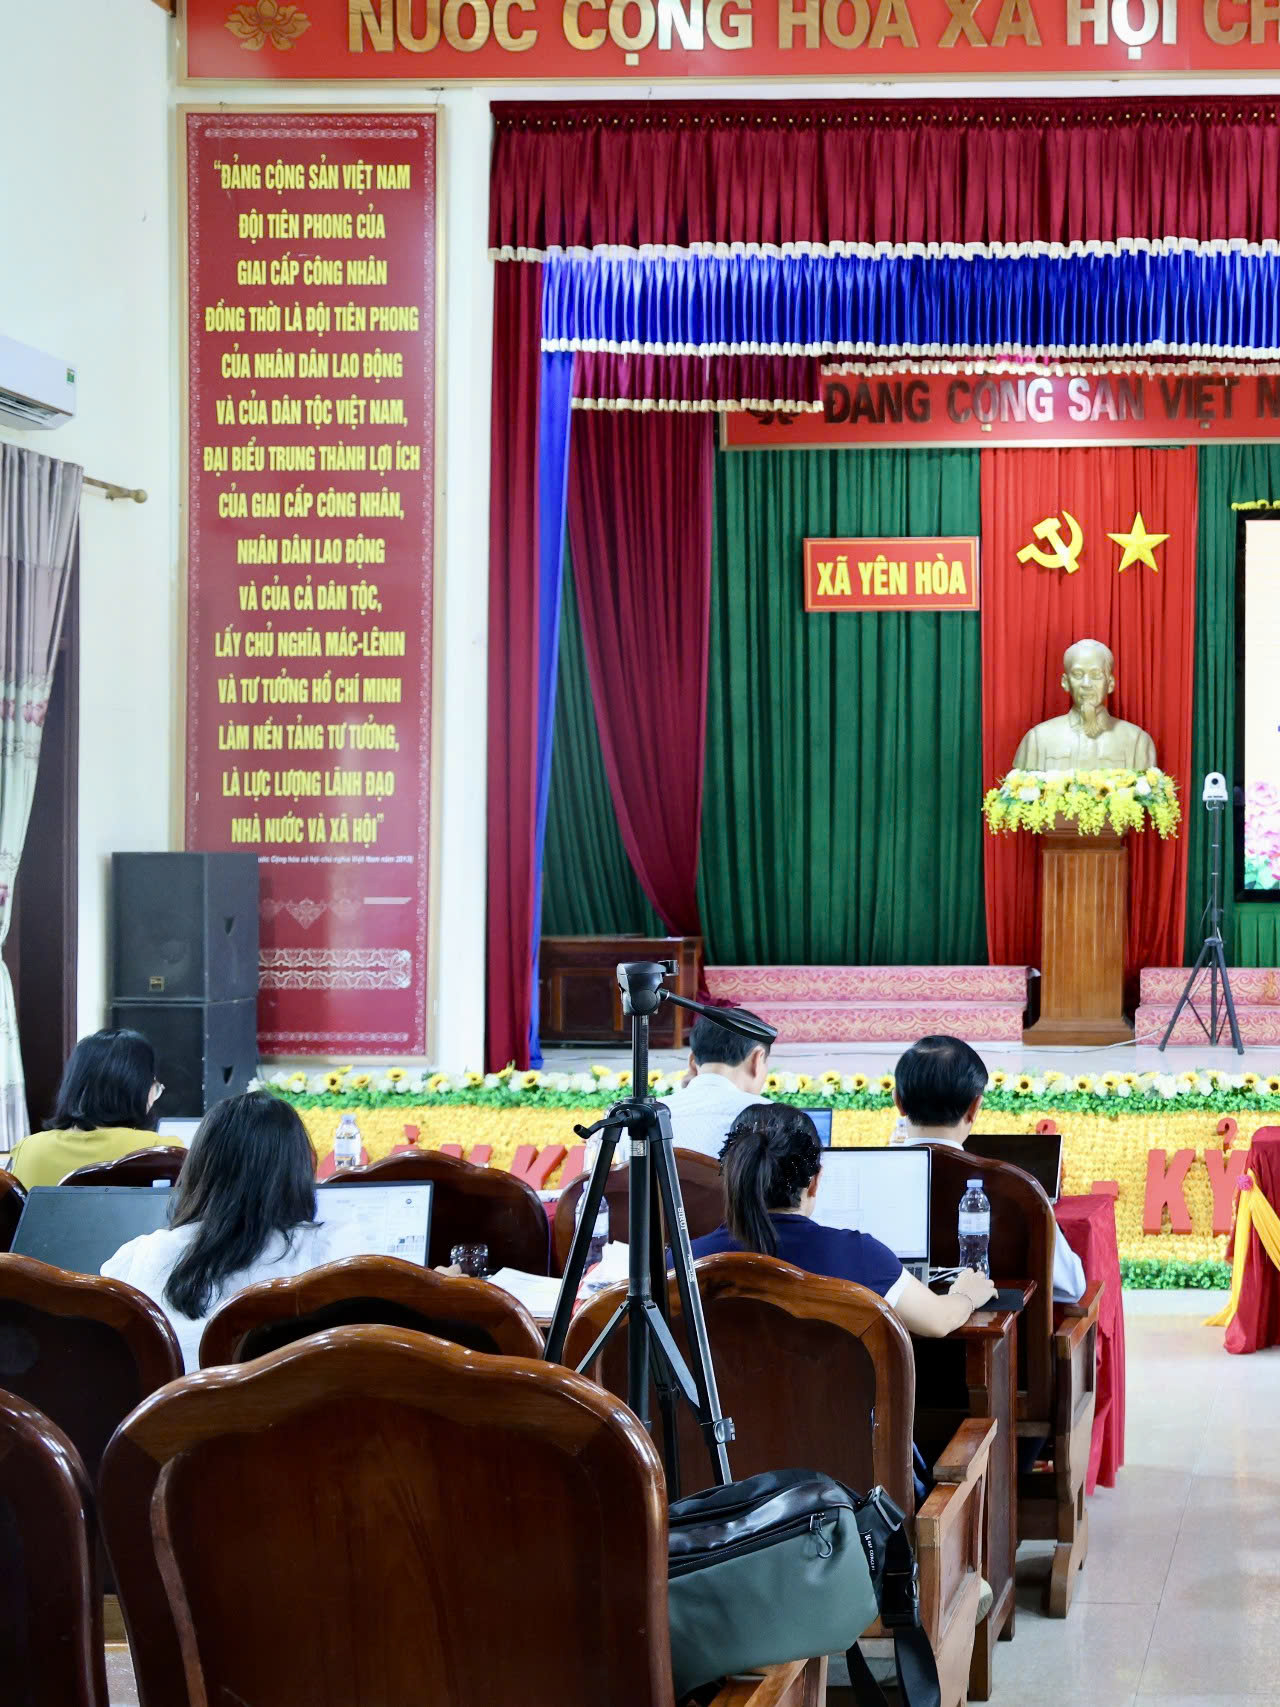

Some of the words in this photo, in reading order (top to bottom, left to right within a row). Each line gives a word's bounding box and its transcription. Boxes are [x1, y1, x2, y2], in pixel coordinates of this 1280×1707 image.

[213, 153, 262, 190] “ĐẢNG
[264, 159, 305, 195] CỘNG
[308, 153, 340, 190] SẢN
[342, 159, 374, 196] VIỆT
[376, 164, 411, 190] NAM
[238, 208, 264, 245] ĐỘI
[266, 208, 300, 239] TIÊN
[303, 213, 353, 240] PHONG
[356, 203, 386, 240] CỦA
[237, 259, 267, 286] GIAI
[270, 251, 300, 286] CẤP
[303, 254, 344, 286] CÔNG
[346, 254, 388, 286] NHÂN
[248, 300, 281, 332] THỜI
[284, 301, 303, 332] LÀ
[305, 301, 331, 337] ĐỘI
[333, 301, 367, 332] TIÊN
[369, 305, 420, 332] PHONG
[203, 446, 229, 477] ĐẠI
[231, 436, 265, 472] BIỂU
[267, 445, 316, 472] TRUNG
[318, 440, 367, 471] THÀNH
[369, 443, 393, 477] LỢI
[395, 439, 421, 471] ÍCH
[218, 482, 249, 519] CỦA
[251, 492, 281, 518] GIAI
[284, 483, 314, 518] CẤP
[316, 486, 357, 518] CÔNG
[359, 486, 405, 520] NHÂN,
[816, 555, 852, 596] XÃ
[857, 554, 908, 596] YÊN
[914, 552, 968, 595] HÒA
[214, 623, 242, 658] LẤY
[244, 621, 275, 658] CHỦ
[277, 626, 323, 657] NGHĨA
[325, 625, 406, 657] MÁC-LÊNIN
[231, 813, 262, 843] NHÀ
[264, 810, 305, 843] NƯỚC
[307, 812, 327, 843] VÀ
[329, 811, 350, 844] XÃ
[351, 811, 385, 849] HỘI”
